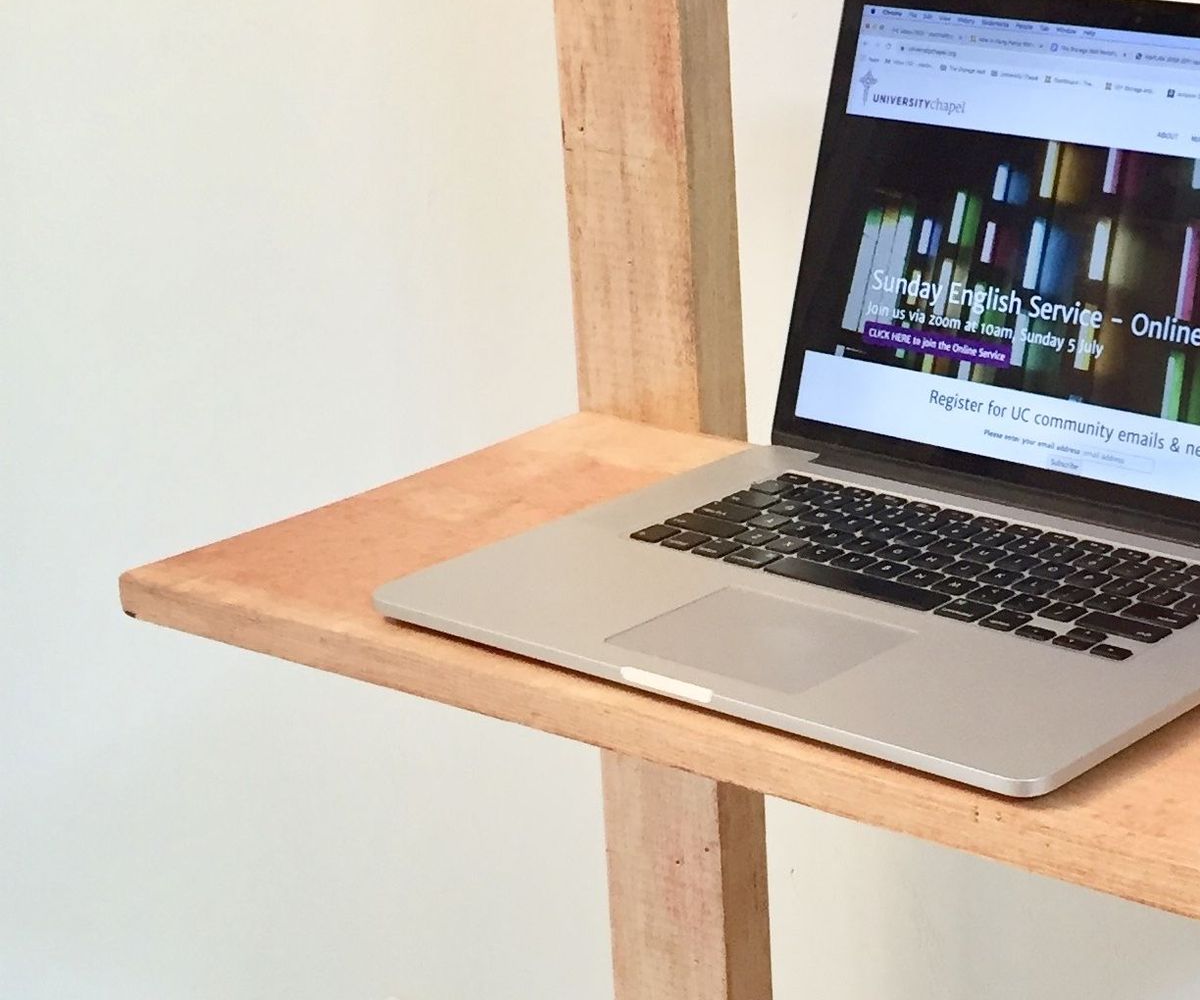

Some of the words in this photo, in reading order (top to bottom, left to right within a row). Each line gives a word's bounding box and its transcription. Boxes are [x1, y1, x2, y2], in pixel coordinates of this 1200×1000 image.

[871, 269, 944, 307] Sunday
[948, 281, 1022, 315] English
[1028, 295, 1103, 330] Service
[866, 301, 890, 317] Join
[892, 308, 906, 321] us
[908, 307, 926, 325] via
[928, 314, 961, 331] zoom
[963, 319, 977, 334] at
[1019, 327, 1066, 353] Sunday
[1067, 336, 1077, 354] 5
[1076, 338, 1105, 360] July
[868, 327, 890, 341] CLICK
[890, 332, 912, 344] HERE
[912, 336, 922, 346] to
[921, 335, 937, 350] join
[938, 339, 951, 352] the
[952, 342, 977, 357] Online
[977, 347, 1007, 362] Service
[929, 389, 984, 412] Register
[987, 399, 1008, 418] for
[1011, 406, 1031, 423] UC
[1034, 412, 1115, 443] community
[1118, 429, 1165, 450] emails
[1169, 436, 1181, 454] &
